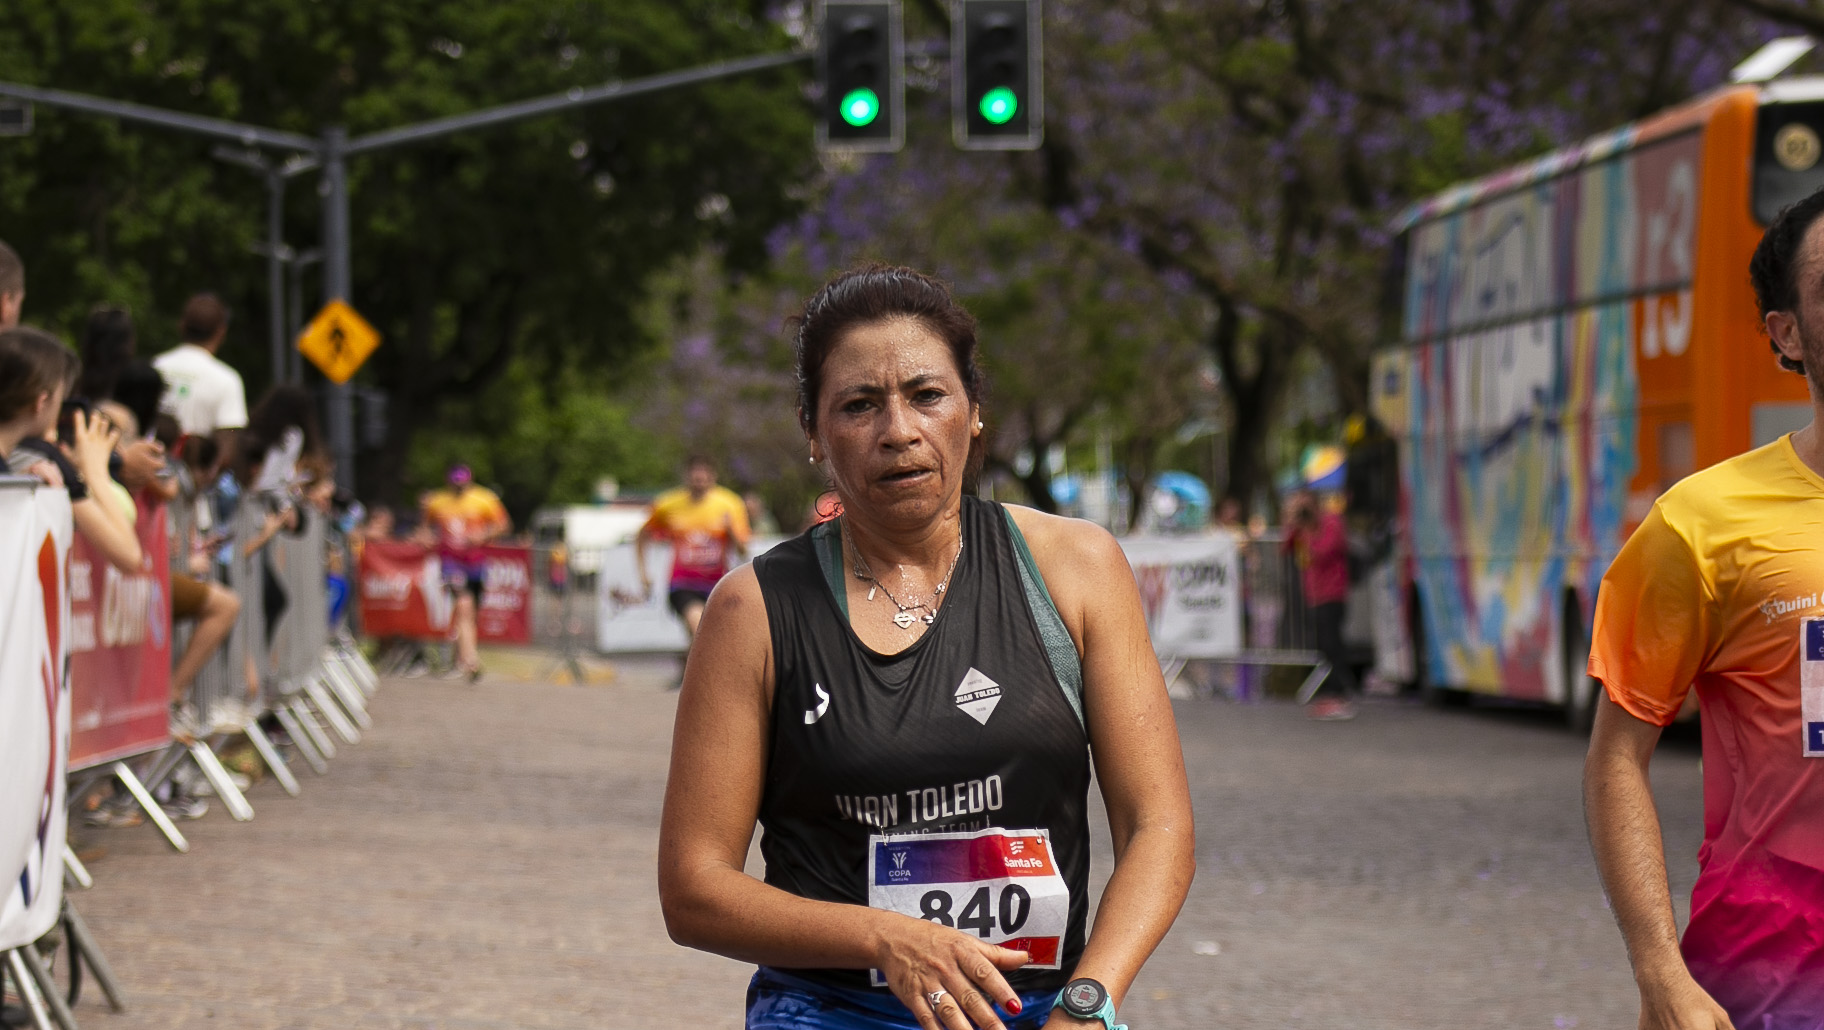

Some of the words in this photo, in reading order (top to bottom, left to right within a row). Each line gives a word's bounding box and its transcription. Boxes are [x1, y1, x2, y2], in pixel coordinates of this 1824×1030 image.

[974, 687, 1001, 699] TOLEDO
[906, 774, 1003, 823] TOLEDO
[1004, 857, 1030, 868] Santa
[1030, 858, 1043, 868] Fe
[888, 869, 911, 877] COPA
[920, 883, 1031, 937] 840
